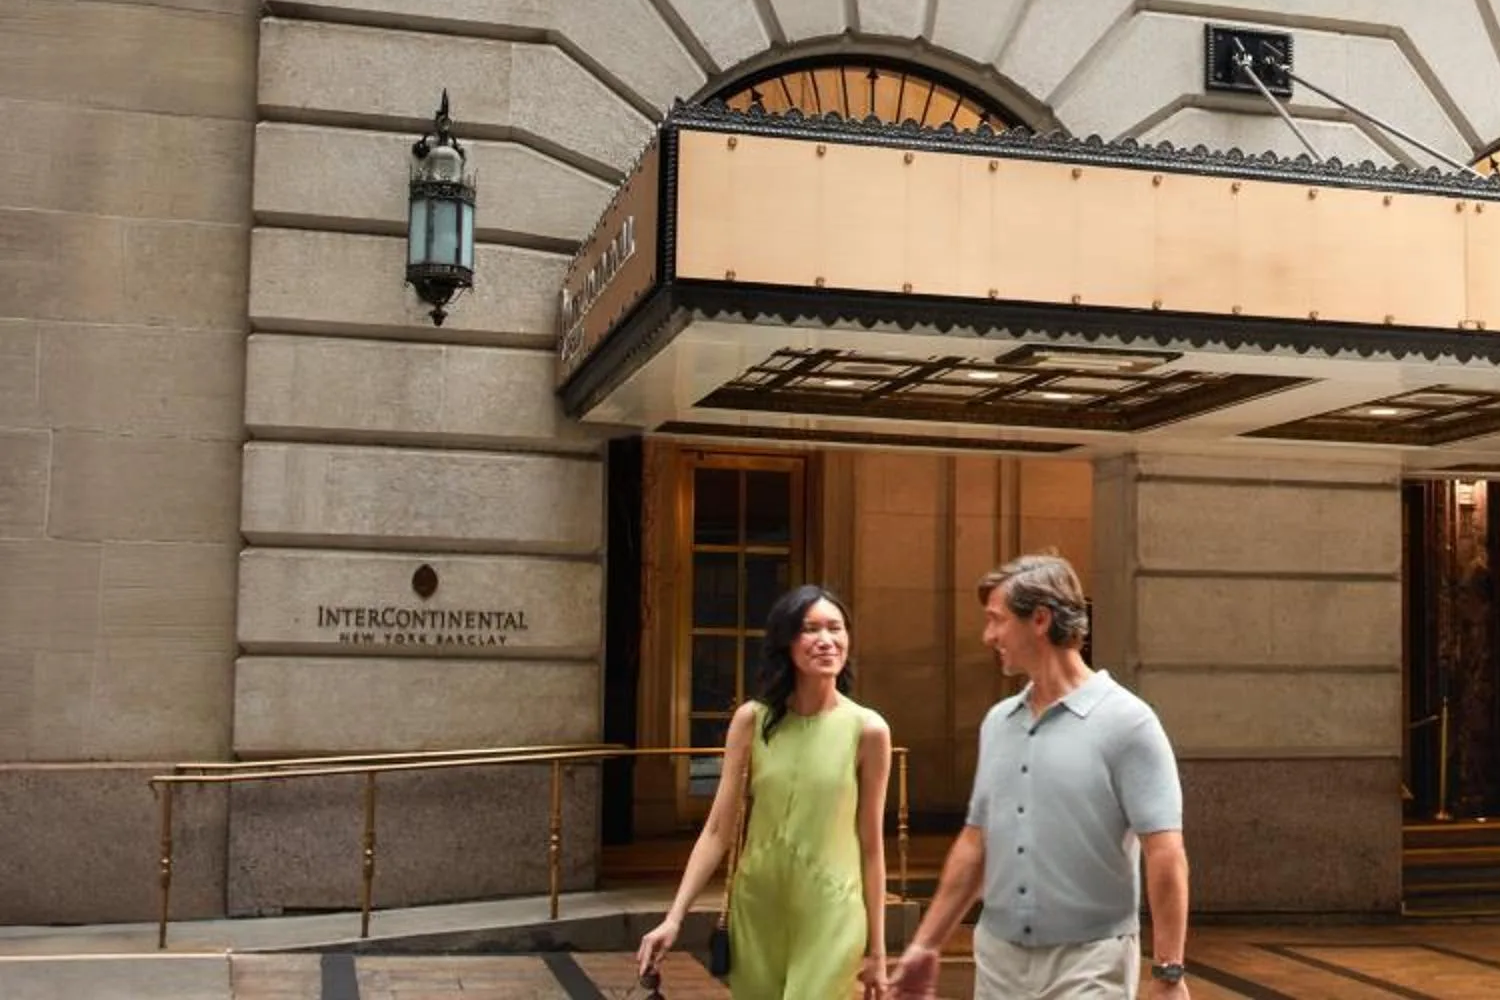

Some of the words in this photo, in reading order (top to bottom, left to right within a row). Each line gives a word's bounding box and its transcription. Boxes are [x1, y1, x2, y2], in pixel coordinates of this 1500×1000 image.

[318, 605, 528, 631] INTERCONTINENTAL
[339, 632, 374, 643] NEW
[384, 633, 427, 645] YORK
[436, 634, 507, 646] BARCLAY
